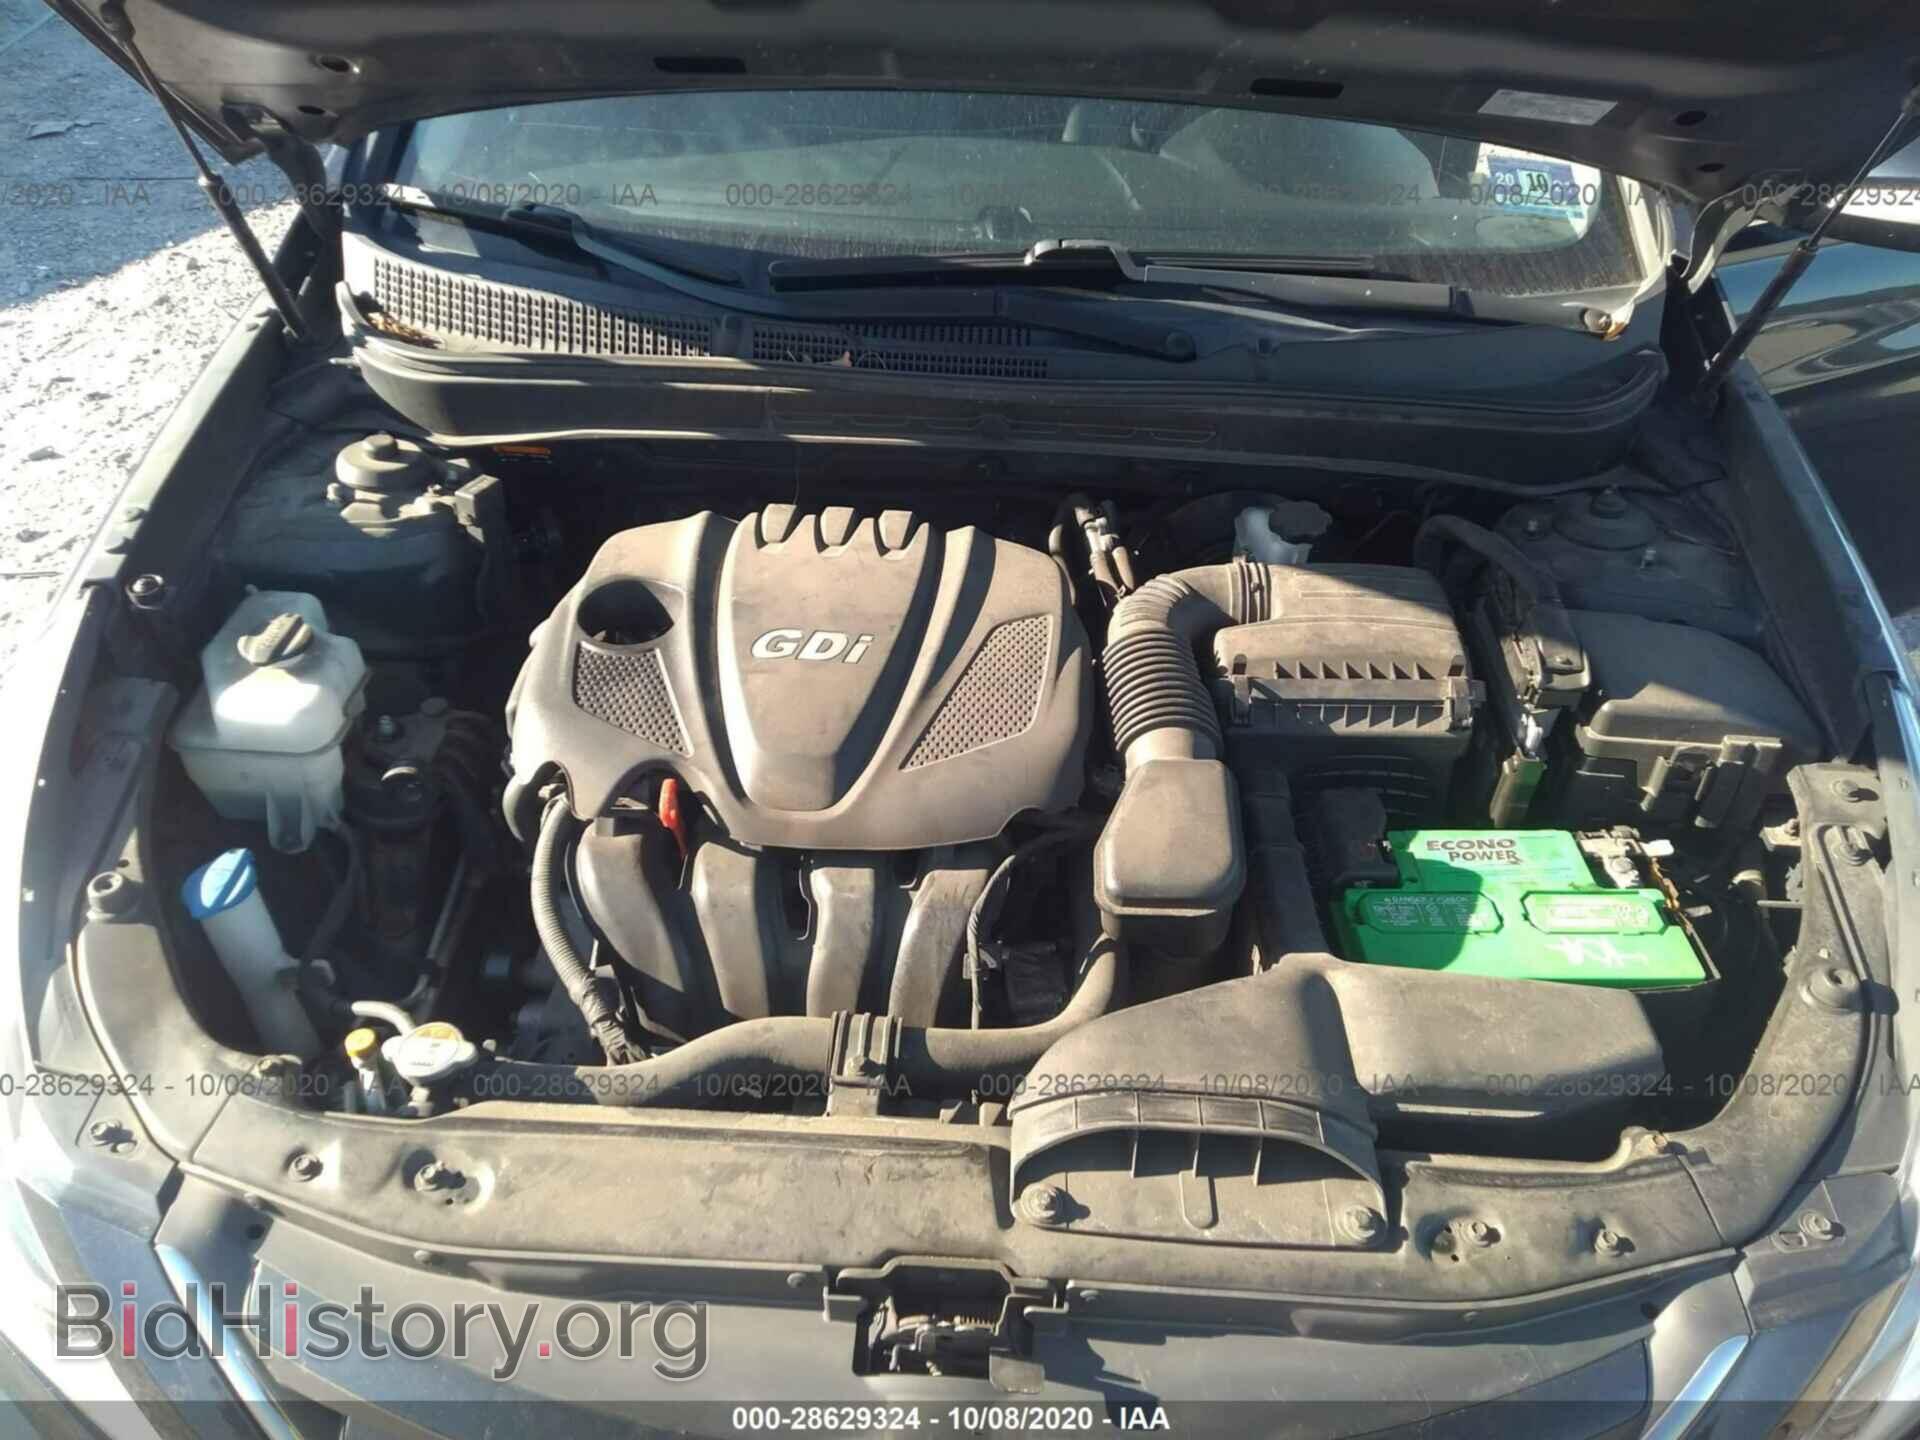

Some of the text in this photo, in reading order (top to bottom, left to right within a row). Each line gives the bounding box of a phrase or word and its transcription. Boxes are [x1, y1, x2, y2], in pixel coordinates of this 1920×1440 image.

[752, 629, 875, 664] GDi
[1426, 839, 1516, 851] ECONO
[1450, 850, 1523, 865] POWER
